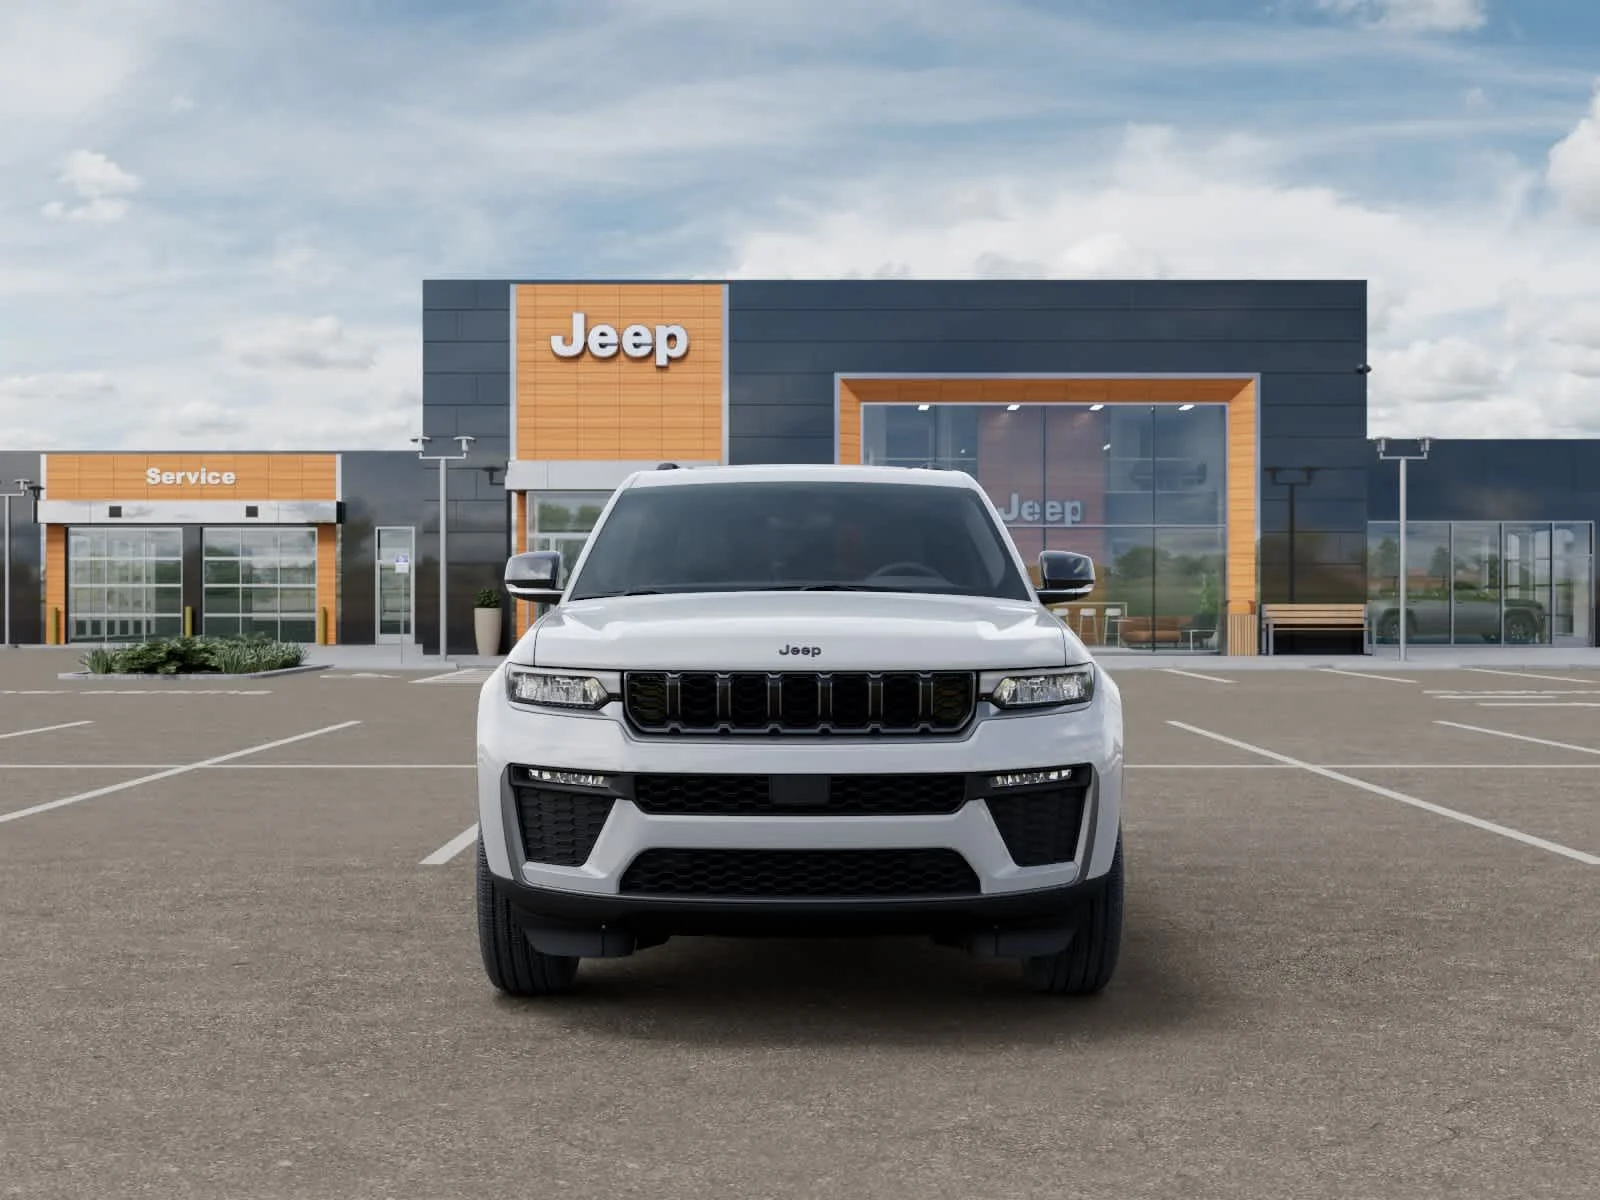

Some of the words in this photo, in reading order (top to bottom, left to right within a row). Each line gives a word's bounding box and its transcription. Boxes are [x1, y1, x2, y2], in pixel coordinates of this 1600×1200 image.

[550, 311, 689, 367] Jeep
[146, 466, 236, 485] Service
[998, 492, 1082, 526] Jeep
[778, 644, 822, 658] Jeep
